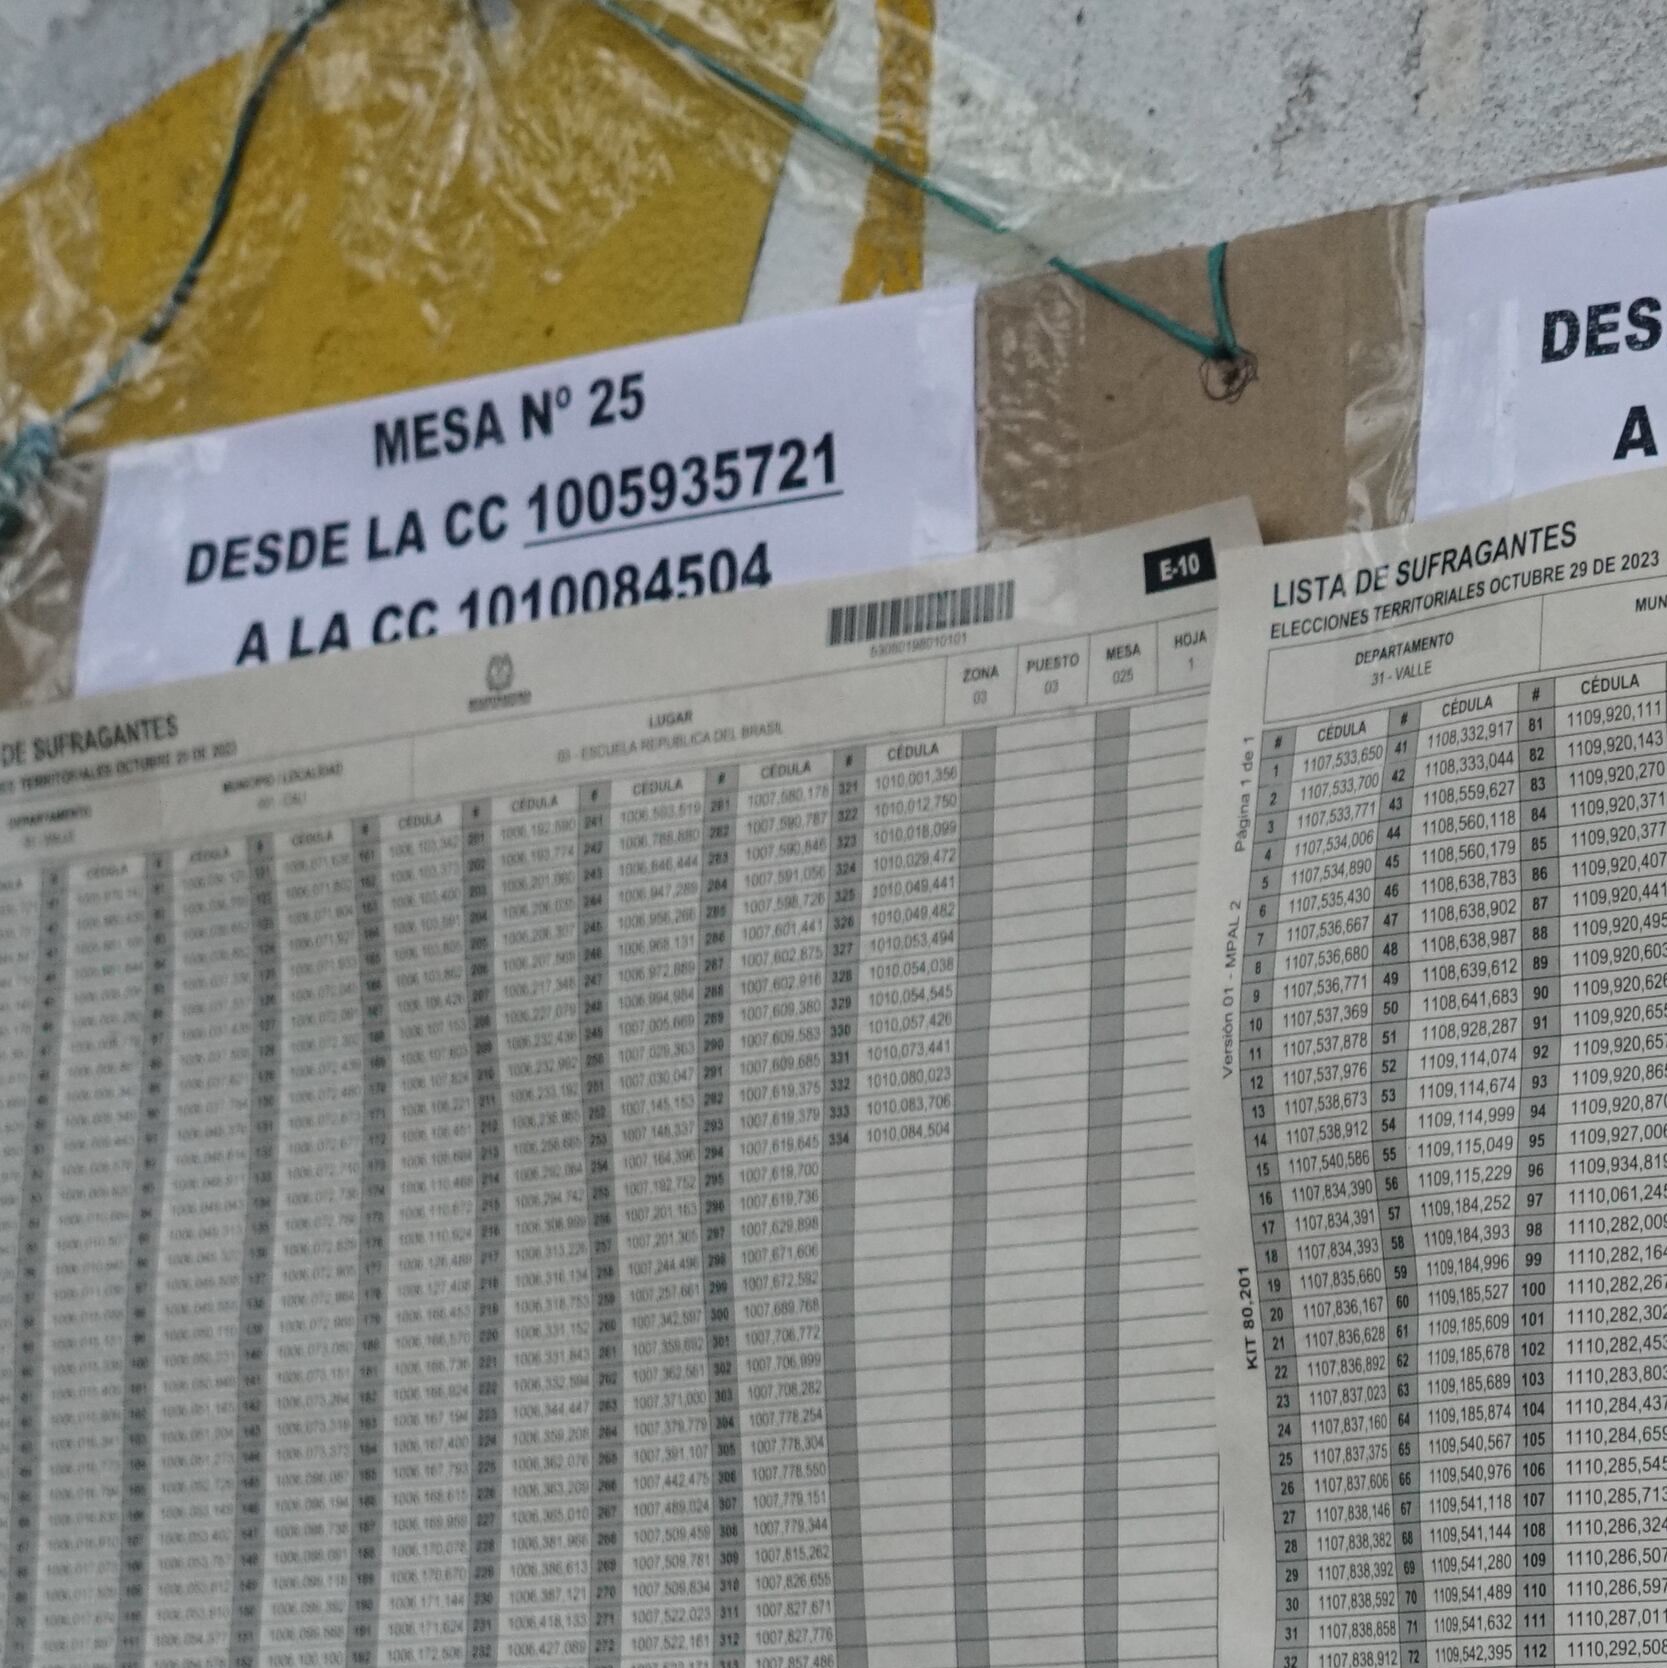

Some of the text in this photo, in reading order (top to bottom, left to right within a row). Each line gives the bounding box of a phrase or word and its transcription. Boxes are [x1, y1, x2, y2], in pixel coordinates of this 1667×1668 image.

[374, 401, 505, 467] MESA
[590, 372, 644, 427] 25
[1613, 405, 1657, 460] A
[186, 432, 843, 584] DESDE LA CC 1005935721
[1160, 553, 1200, 581] E-10
[1271, 550, 1659, 639] ELECCIONES TERRITORIALES OCTUBRE 29 DE 2023
[1273, 520, 1578, 608] LISTA DE SUFRAGANTES
[237, 539, 771, 669] A LA CC 1010084504
[1354, 630, 1455, 666] DEPARTAMENTO
[1371, 672, 1384, 686] 31
[1396, 661, 1432, 680] VALLE
[1245, 1336, 1258, 1370] KIT
